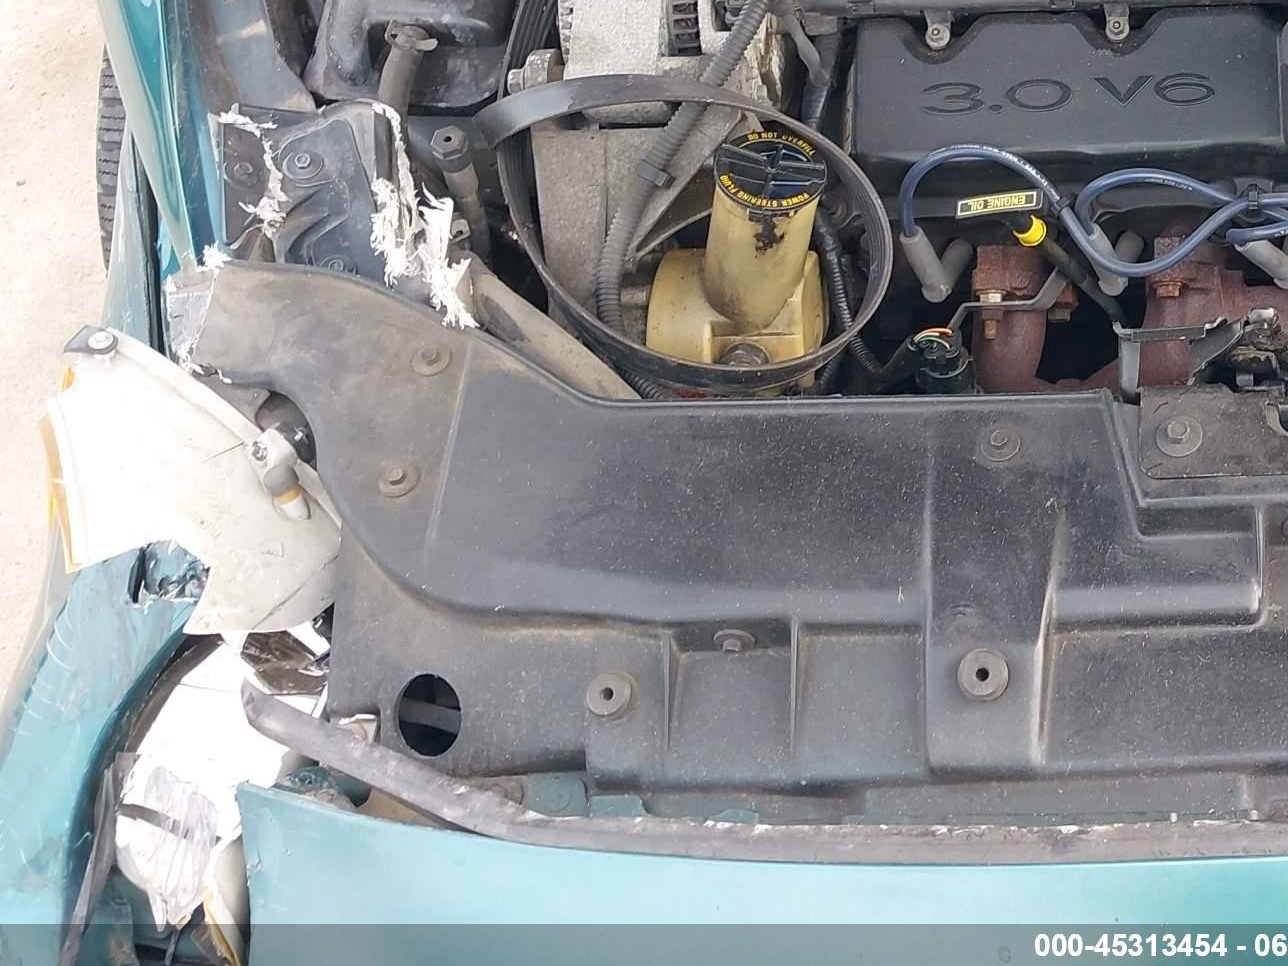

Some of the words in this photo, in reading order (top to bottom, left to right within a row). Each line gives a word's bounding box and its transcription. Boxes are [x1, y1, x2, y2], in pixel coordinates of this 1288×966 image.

[920, 78, 1073, 116] 3.0
[1094, 72, 1216, 107] V6
[782, 133, 816, 156] OVERFILL
[719, 175, 739, 194] FLUID
[737, 193, 778, 208] STEERING
[781, 192, 810, 207] POWER
[967, 200, 985, 211] OIL
[986, 195, 1026, 210] ENGINE
